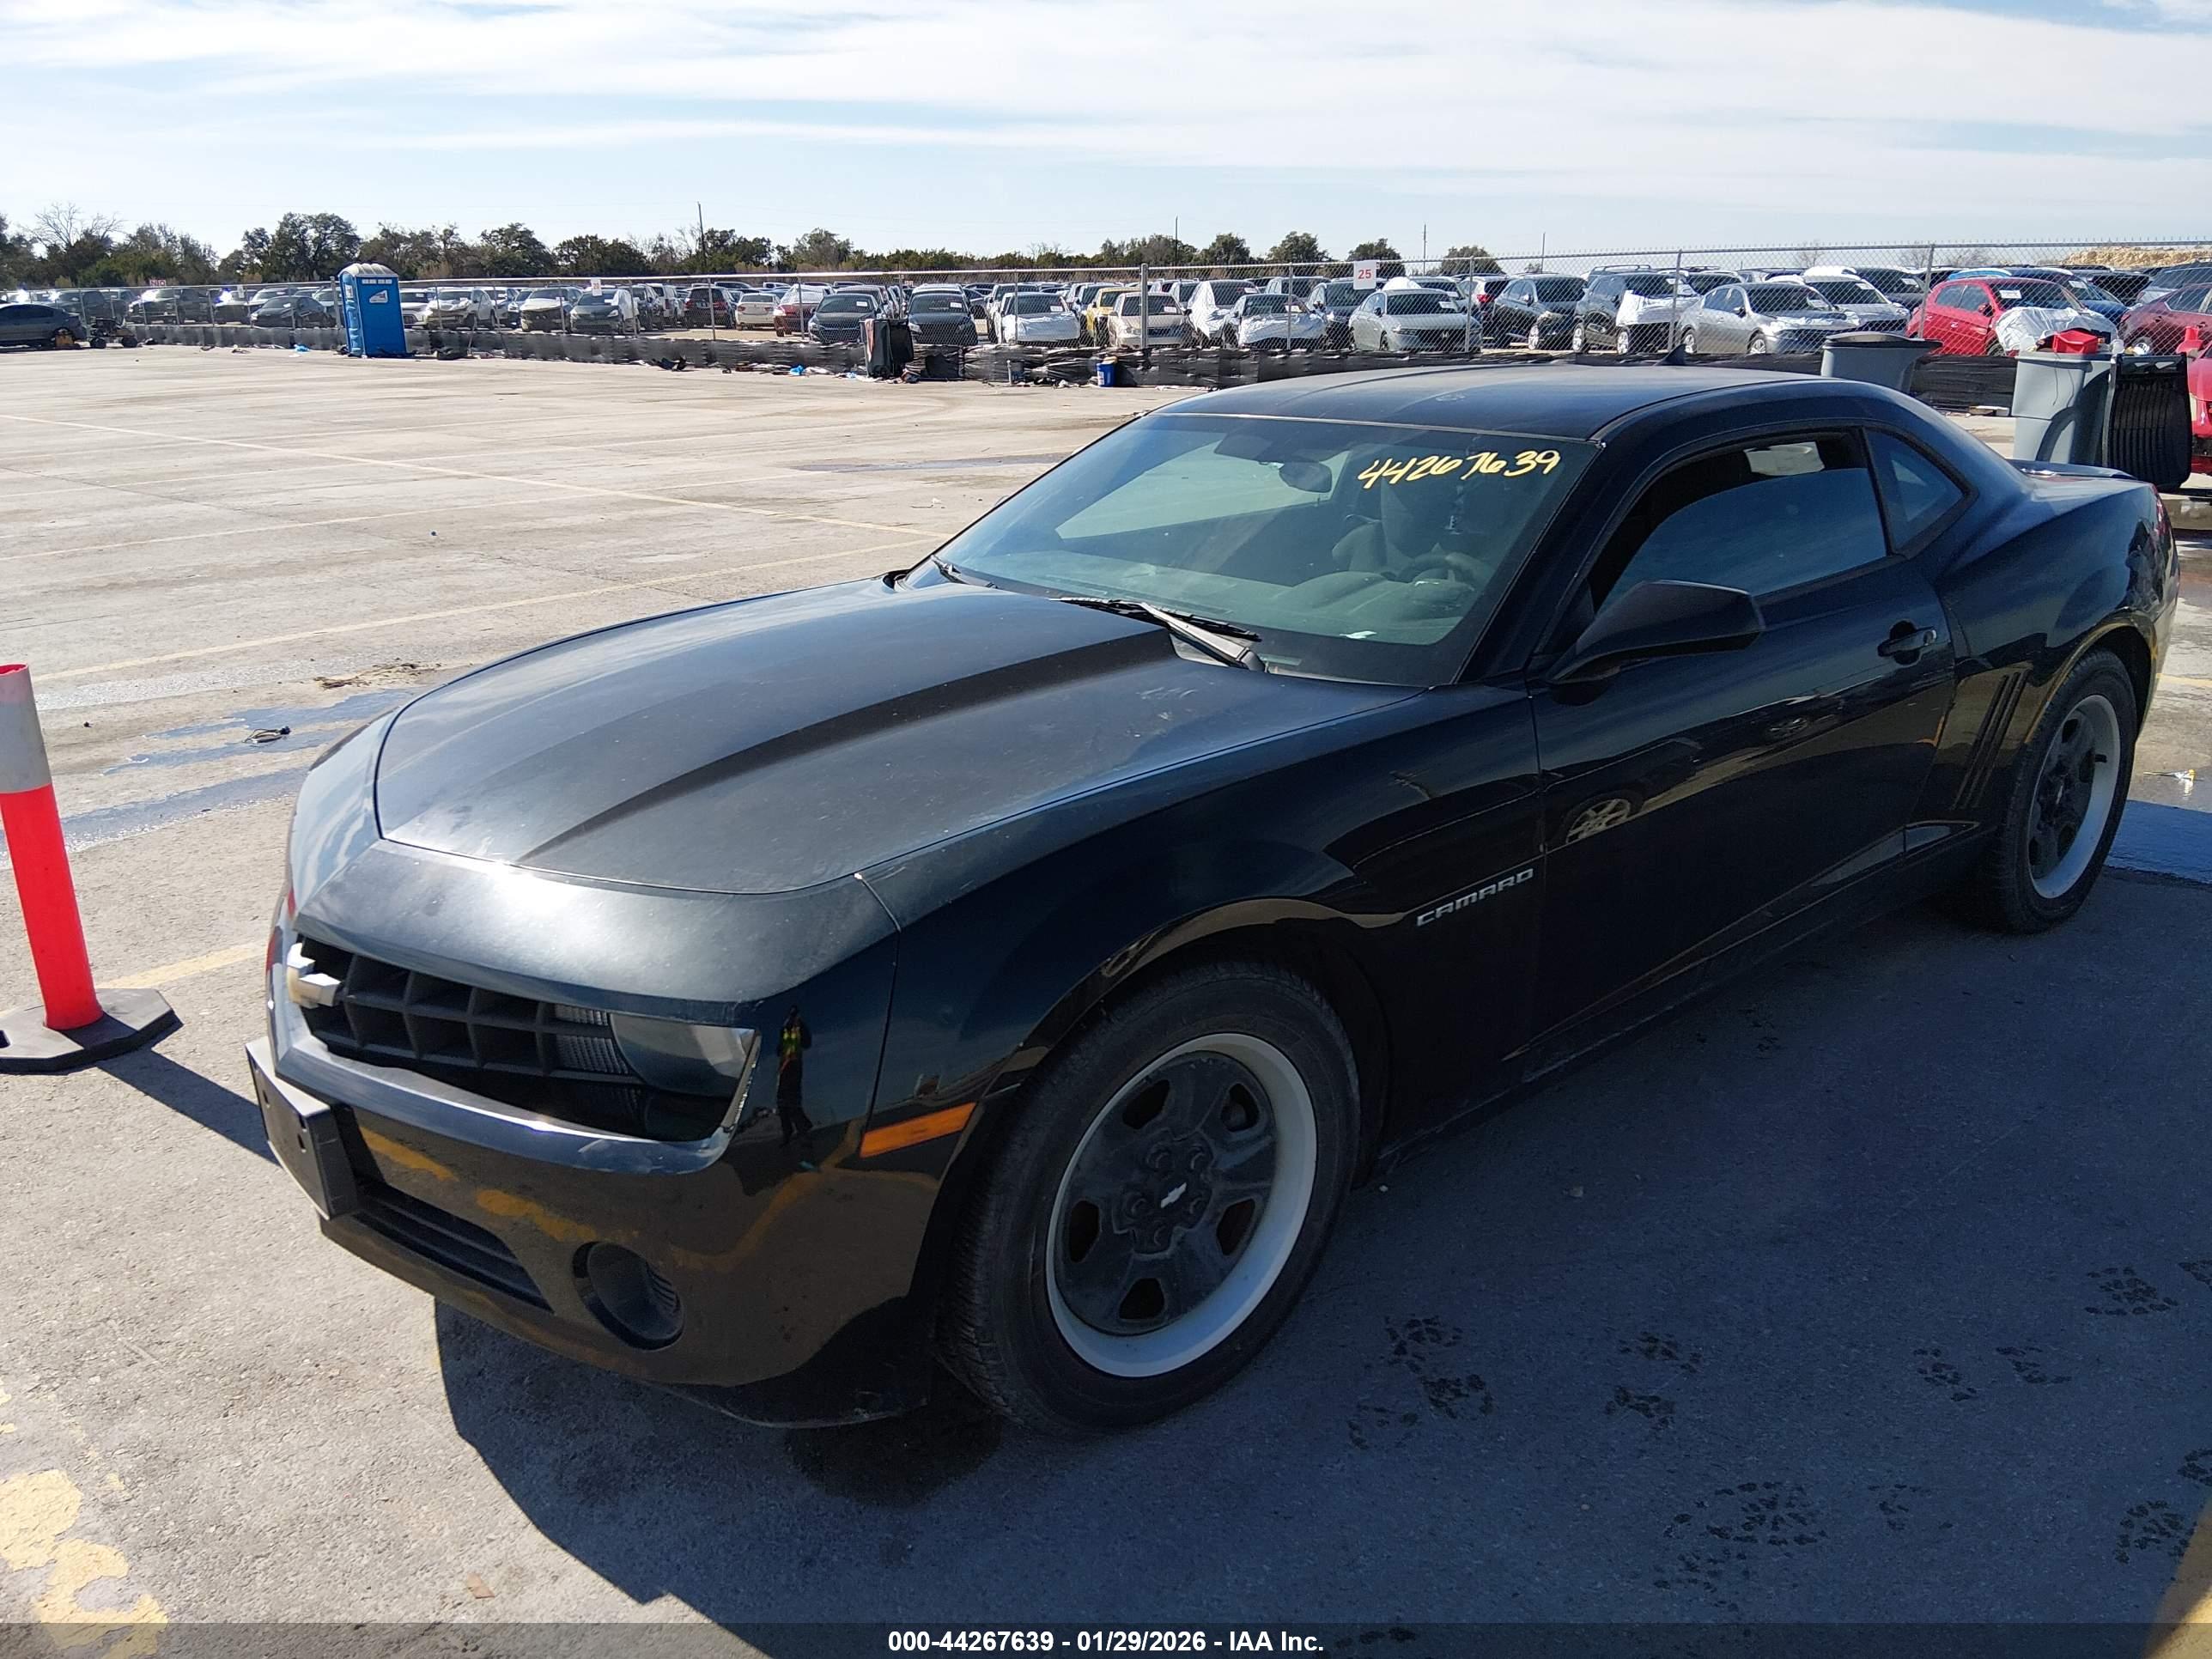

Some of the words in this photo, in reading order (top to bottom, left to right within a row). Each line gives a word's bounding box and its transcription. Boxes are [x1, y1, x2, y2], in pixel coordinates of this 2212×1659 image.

[1358, 269, 1371, 280] 25
[1358, 450, 1561, 489] 44267639
[1417, 868, 1534, 927] CAMARO
